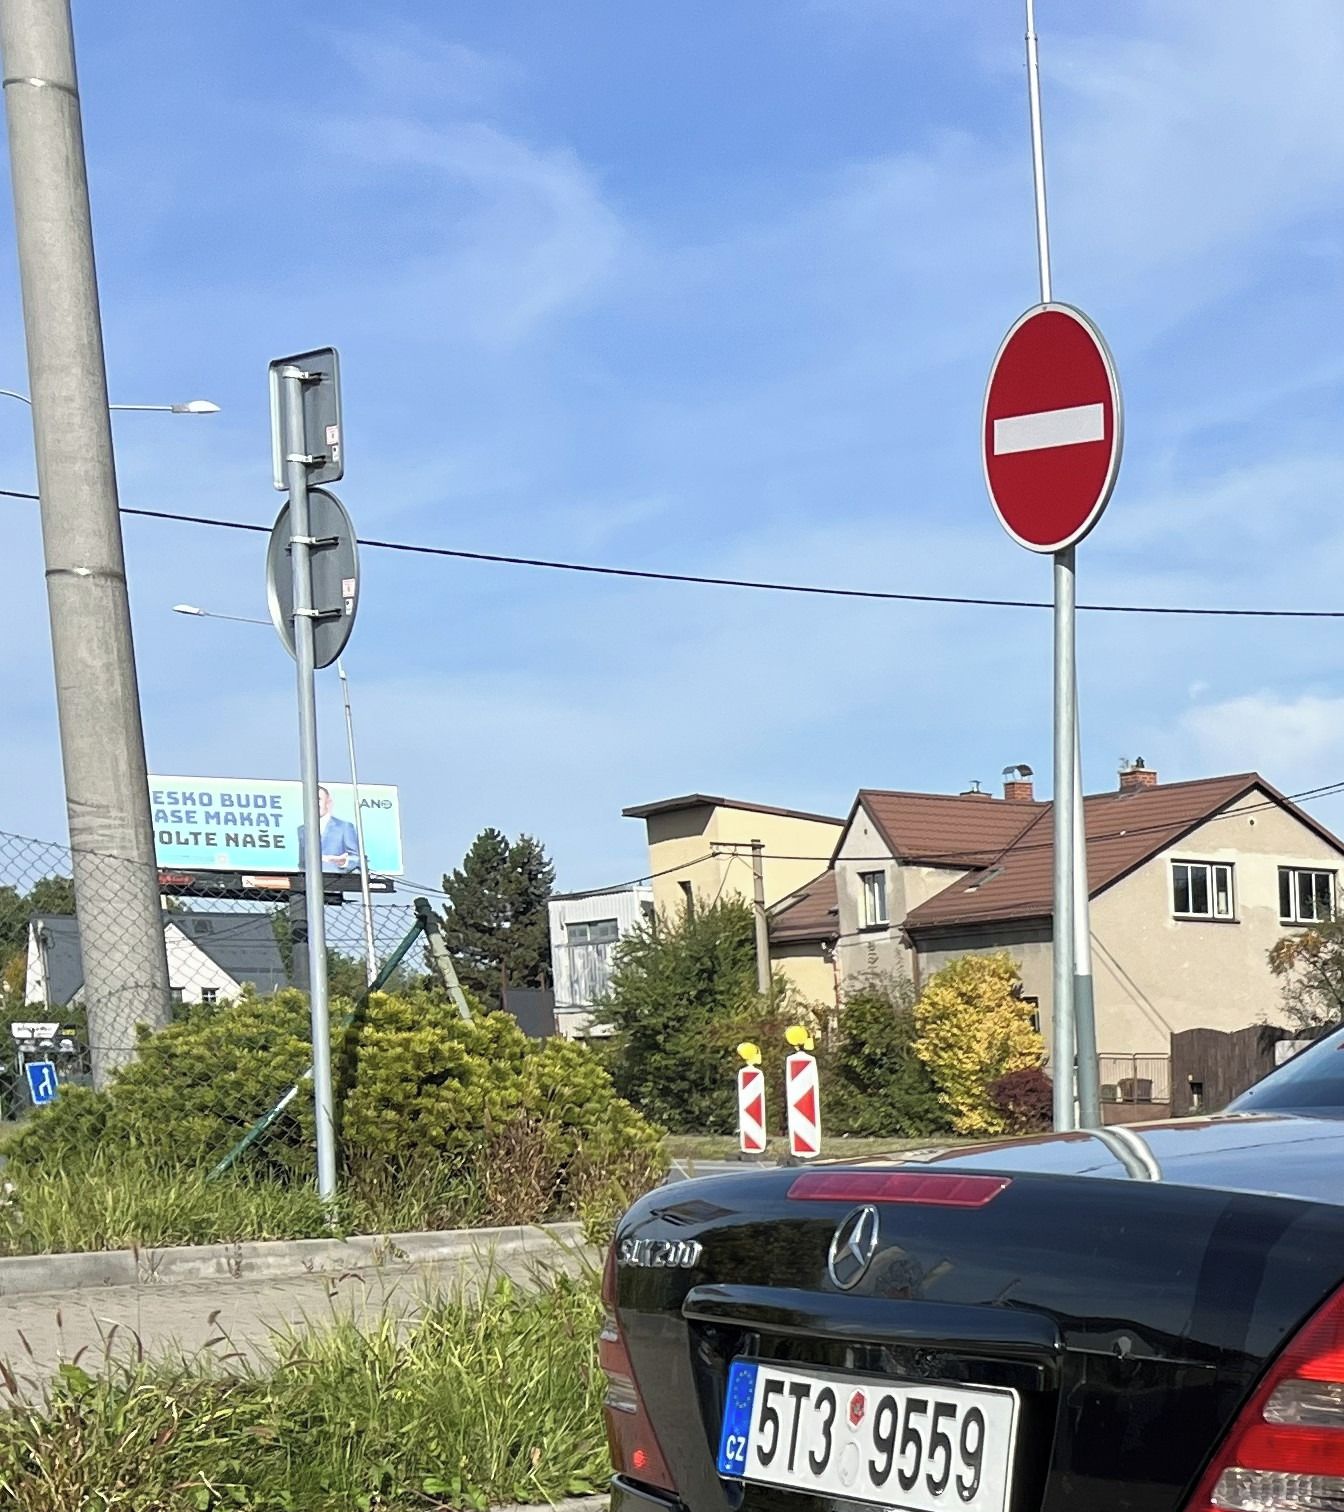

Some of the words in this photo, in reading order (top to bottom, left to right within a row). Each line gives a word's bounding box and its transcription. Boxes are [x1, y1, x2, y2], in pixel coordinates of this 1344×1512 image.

[151, 790, 213, 807] ESKO
[220, 792, 283, 810] BUDE
[154, 809, 198, 825] ASE
[204, 810, 283, 828] MAKAT
[153, 830, 218, 847] OLTE
[225, 829, 286, 849] NAŠE
[726, 1434, 746, 1462] CZ
[756, 1378, 837, 1476] 5T3
[868, 1394, 985, 1502] 9559
